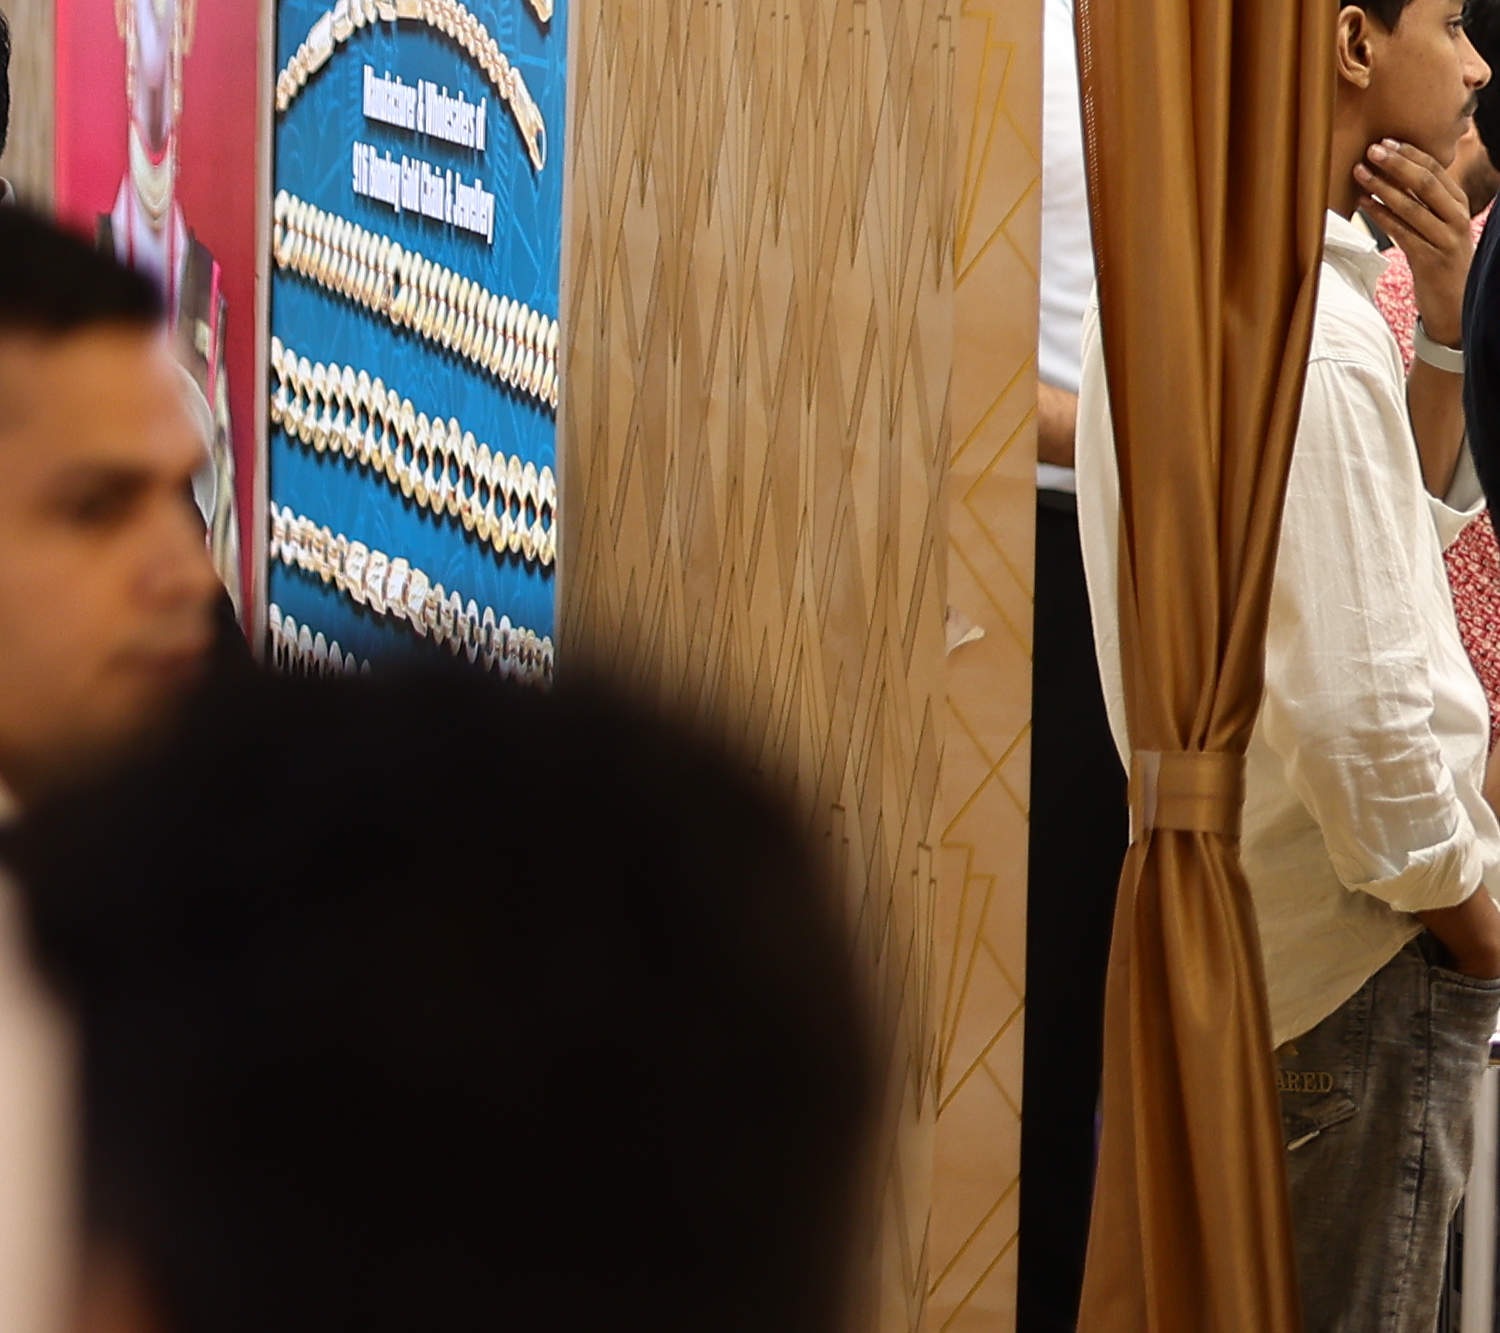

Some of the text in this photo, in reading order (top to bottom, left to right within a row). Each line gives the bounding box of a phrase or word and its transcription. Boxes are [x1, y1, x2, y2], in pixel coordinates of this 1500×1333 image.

[417, 78, 425, 133] &
[475, 96, 487, 151] of
[352, 140, 369, 196] 916
[445, 169, 453, 224] &
